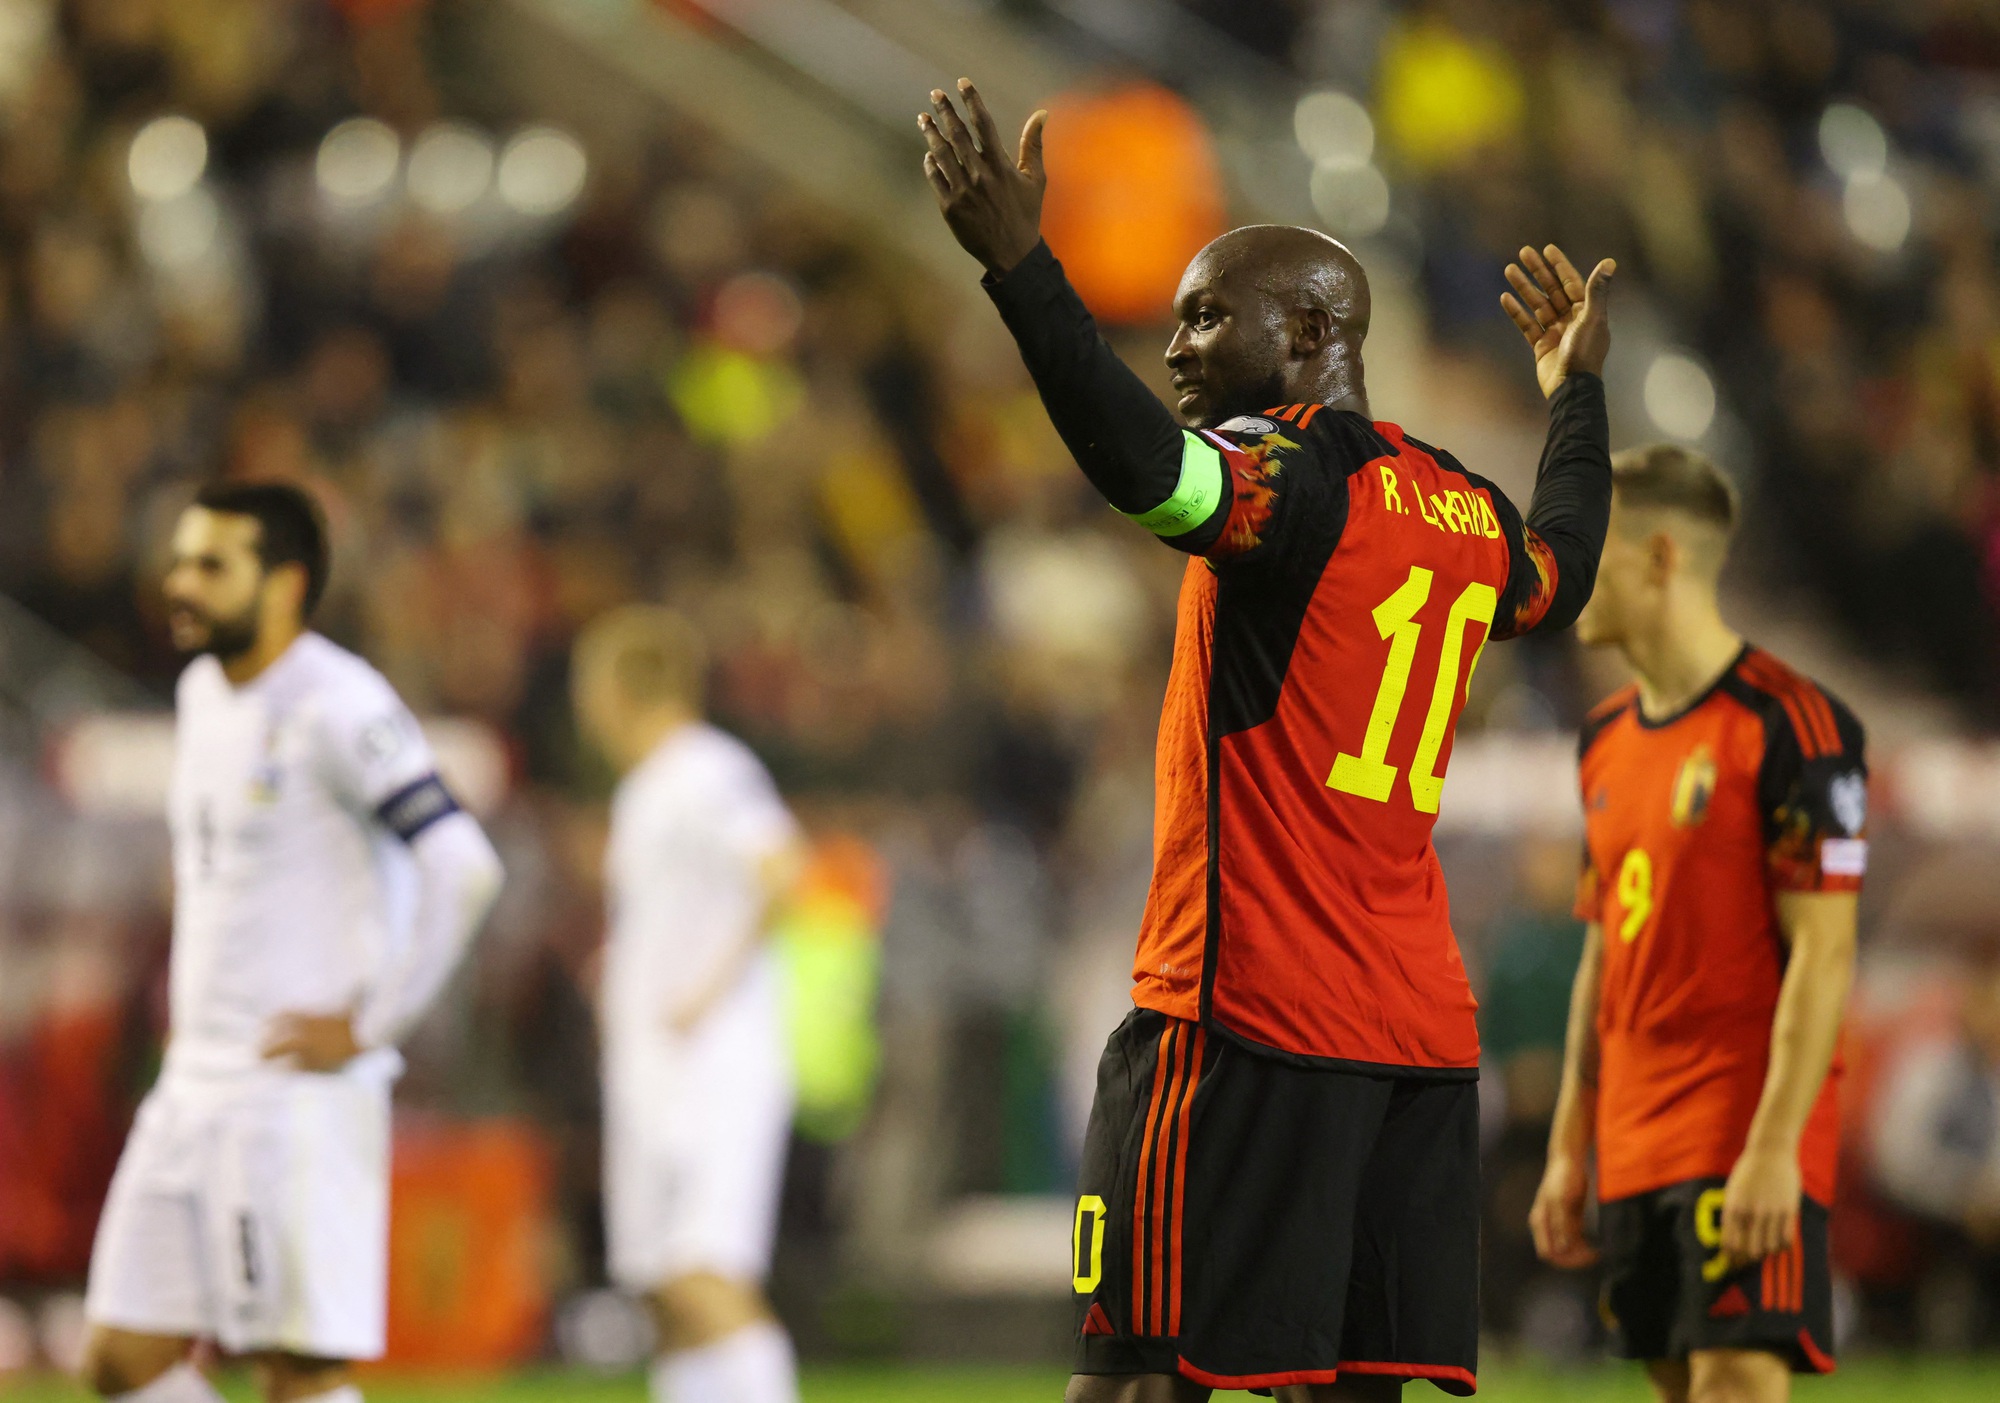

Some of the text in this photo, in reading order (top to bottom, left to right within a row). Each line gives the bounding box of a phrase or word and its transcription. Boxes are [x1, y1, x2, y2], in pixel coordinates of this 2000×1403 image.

[1380, 466, 1409, 515] R.
[1325, 565, 1497, 814] 10
[1618, 848, 1652, 943] 9
